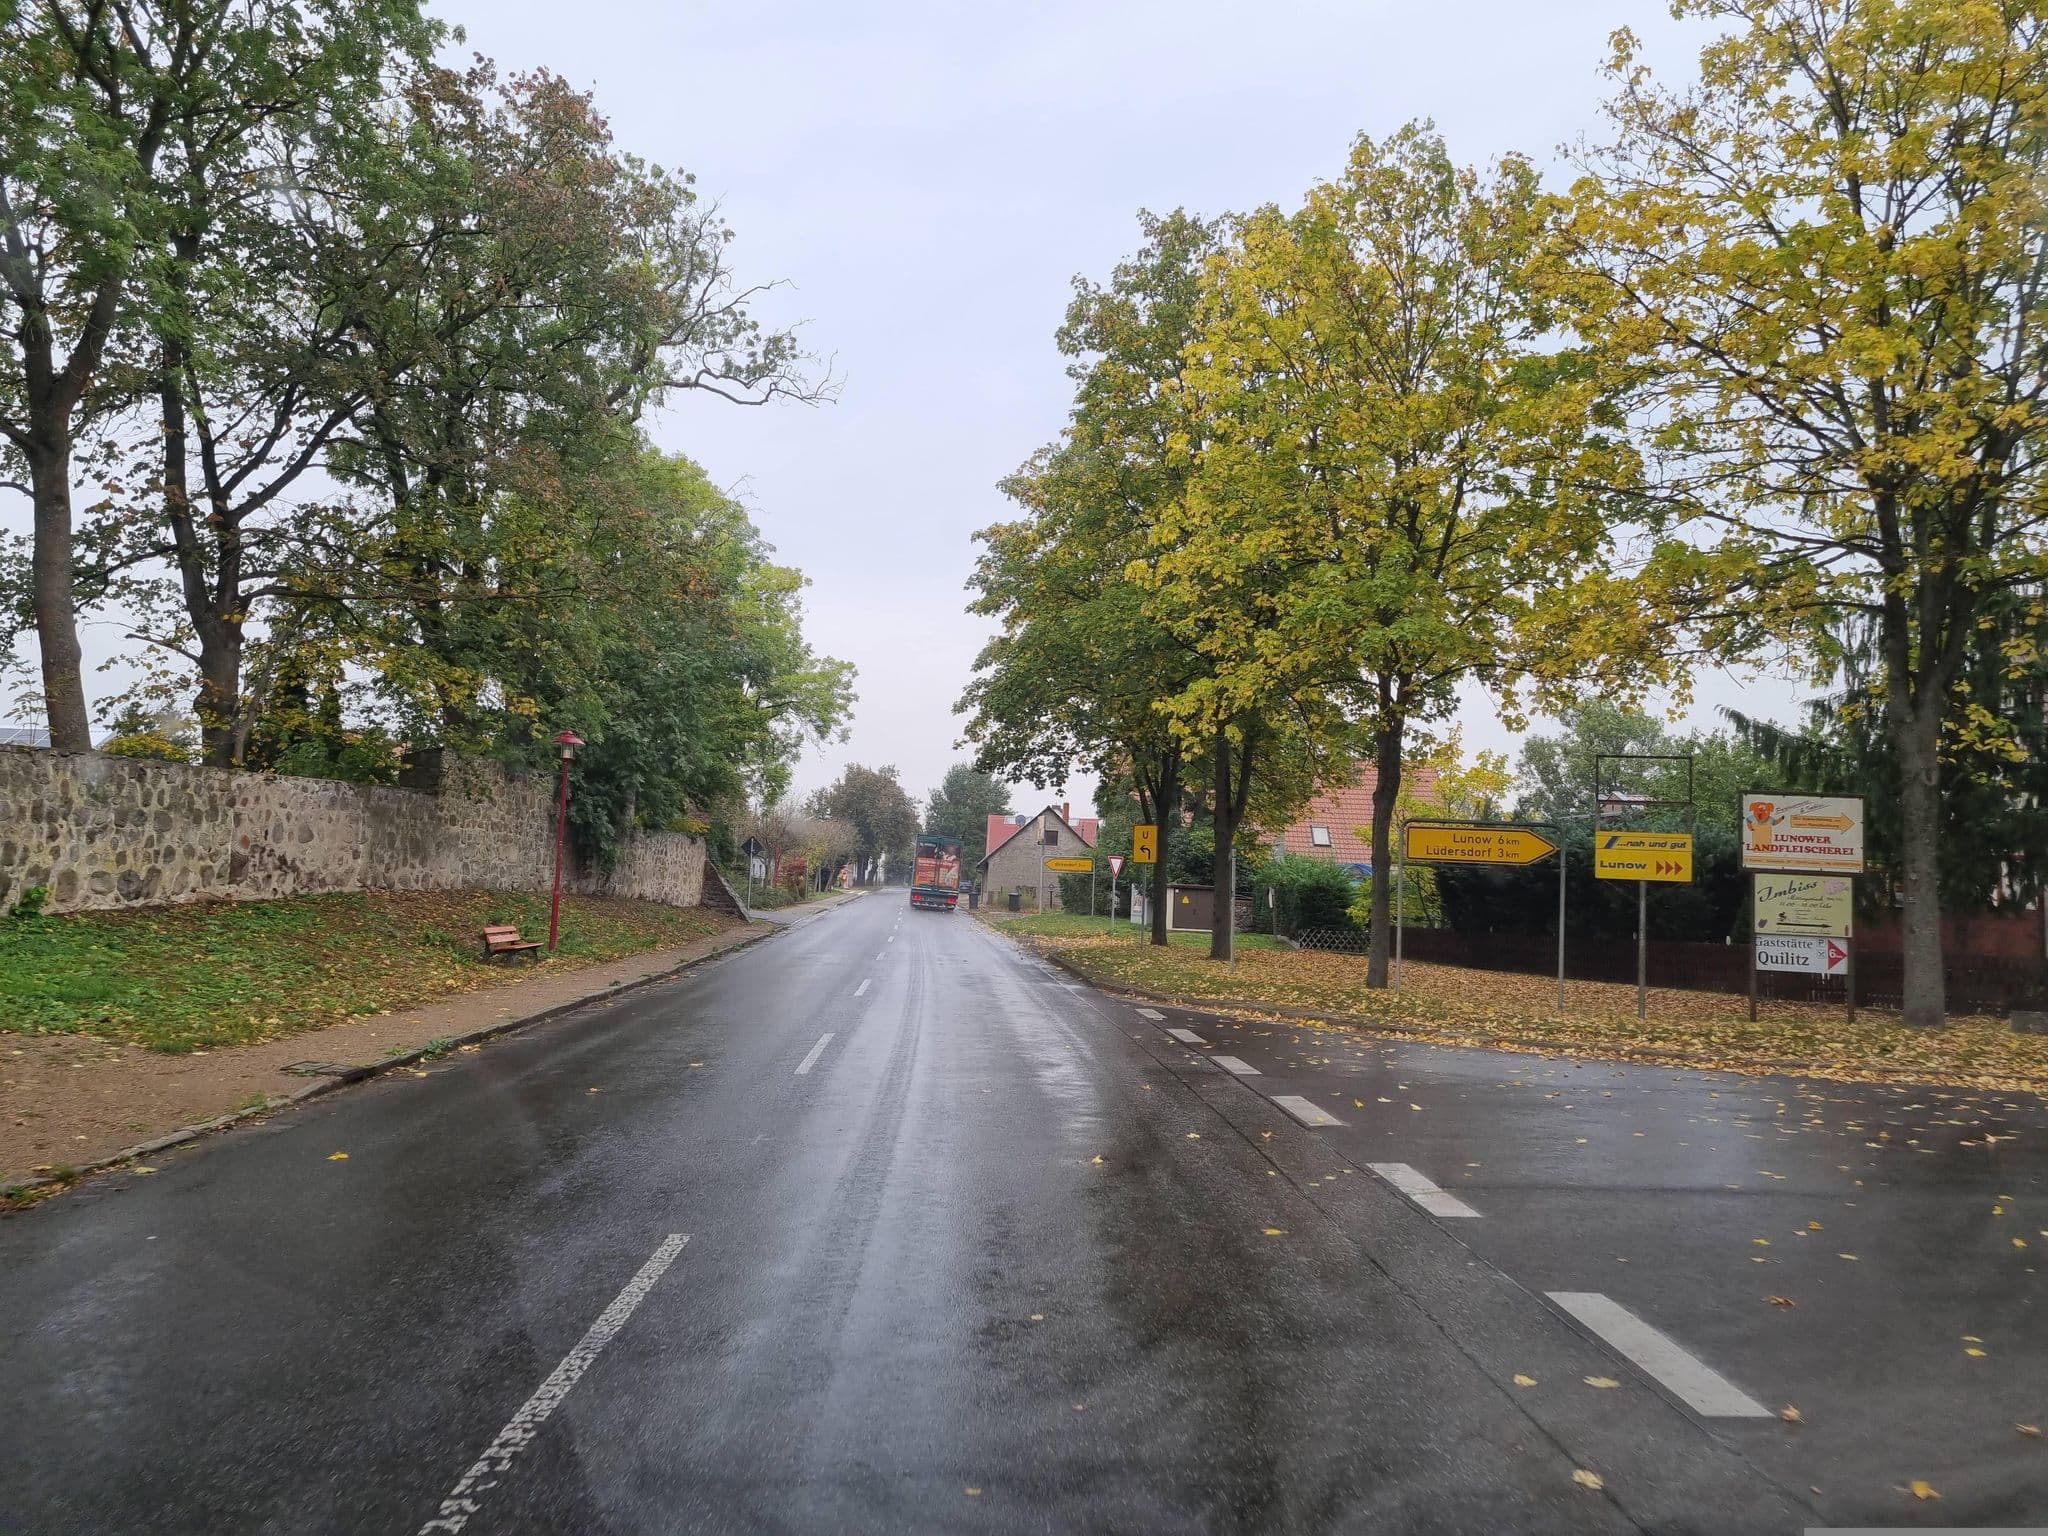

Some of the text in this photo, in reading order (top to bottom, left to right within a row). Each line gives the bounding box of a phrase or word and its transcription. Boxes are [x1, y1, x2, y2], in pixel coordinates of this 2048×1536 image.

[1142, 831, 1149, 839] U
[1453, 834, 1520, 846] Lunow 6 km
[1774, 834, 1831, 844] LUNOWER
[1426, 845, 1520, 859] Lüdersdorf 3 km
[1746, 843, 1854, 855] LANDFLEISCHEREI
[1600, 861, 1647, 870] Lunow
[1757, 880, 1818, 902] Imbiss
[1755, 937, 1813, 949] Gaststätte
[1758, 951, 1810, 966] Quilitz
